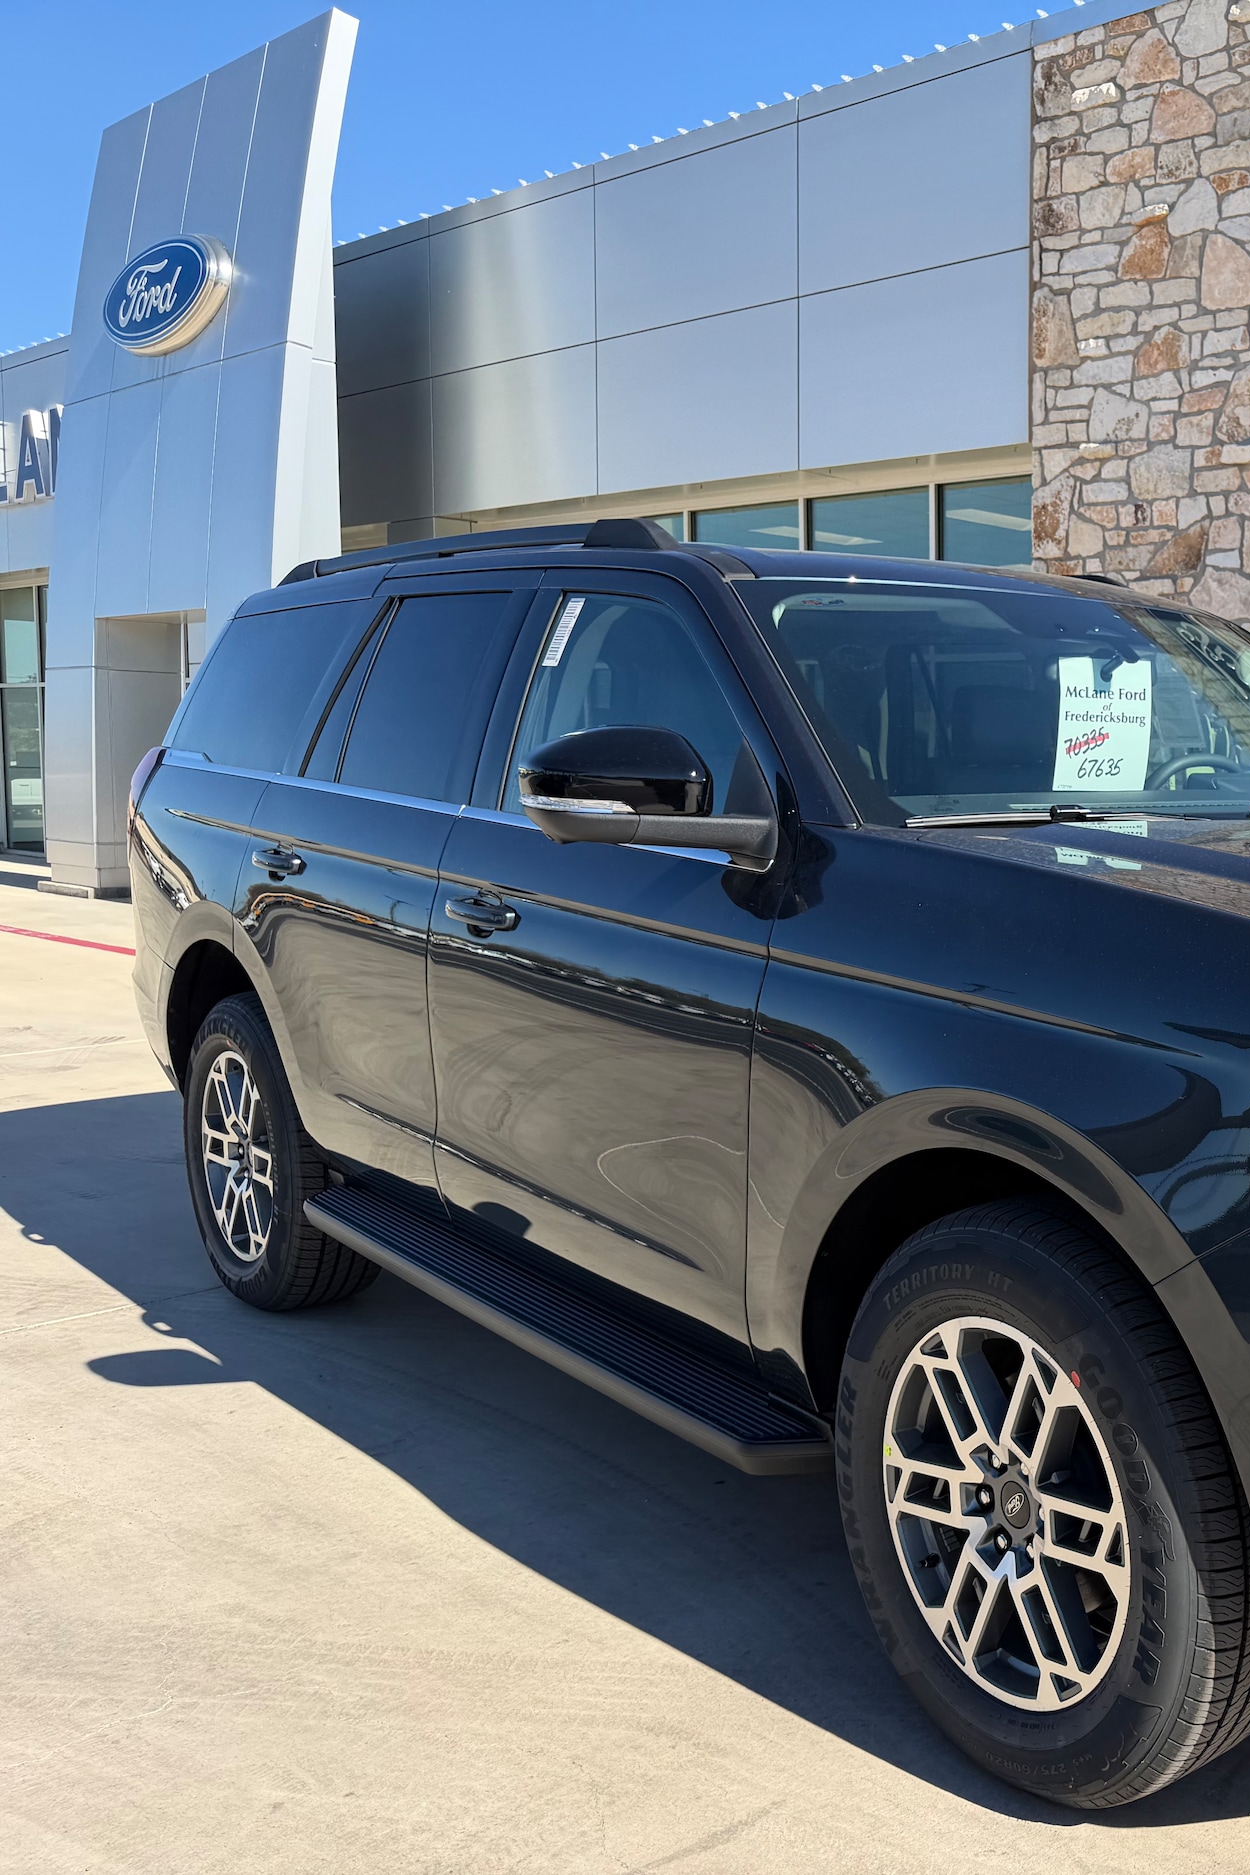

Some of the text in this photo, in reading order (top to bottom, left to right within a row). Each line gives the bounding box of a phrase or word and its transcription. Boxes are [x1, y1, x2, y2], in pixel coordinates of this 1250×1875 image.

[119, 259, 182, 328] Ford
[1065, 686, 1146, 701] McLane Ford
[1102, 702, 1112, 712] of
[1065, 710, 1146, 728] Fredericksburg
[1077, 757, 1124, 779] 67635
[882, 1262, 977, 1312] TERRITORY
[987, 1269, 1016, 1293] HT
